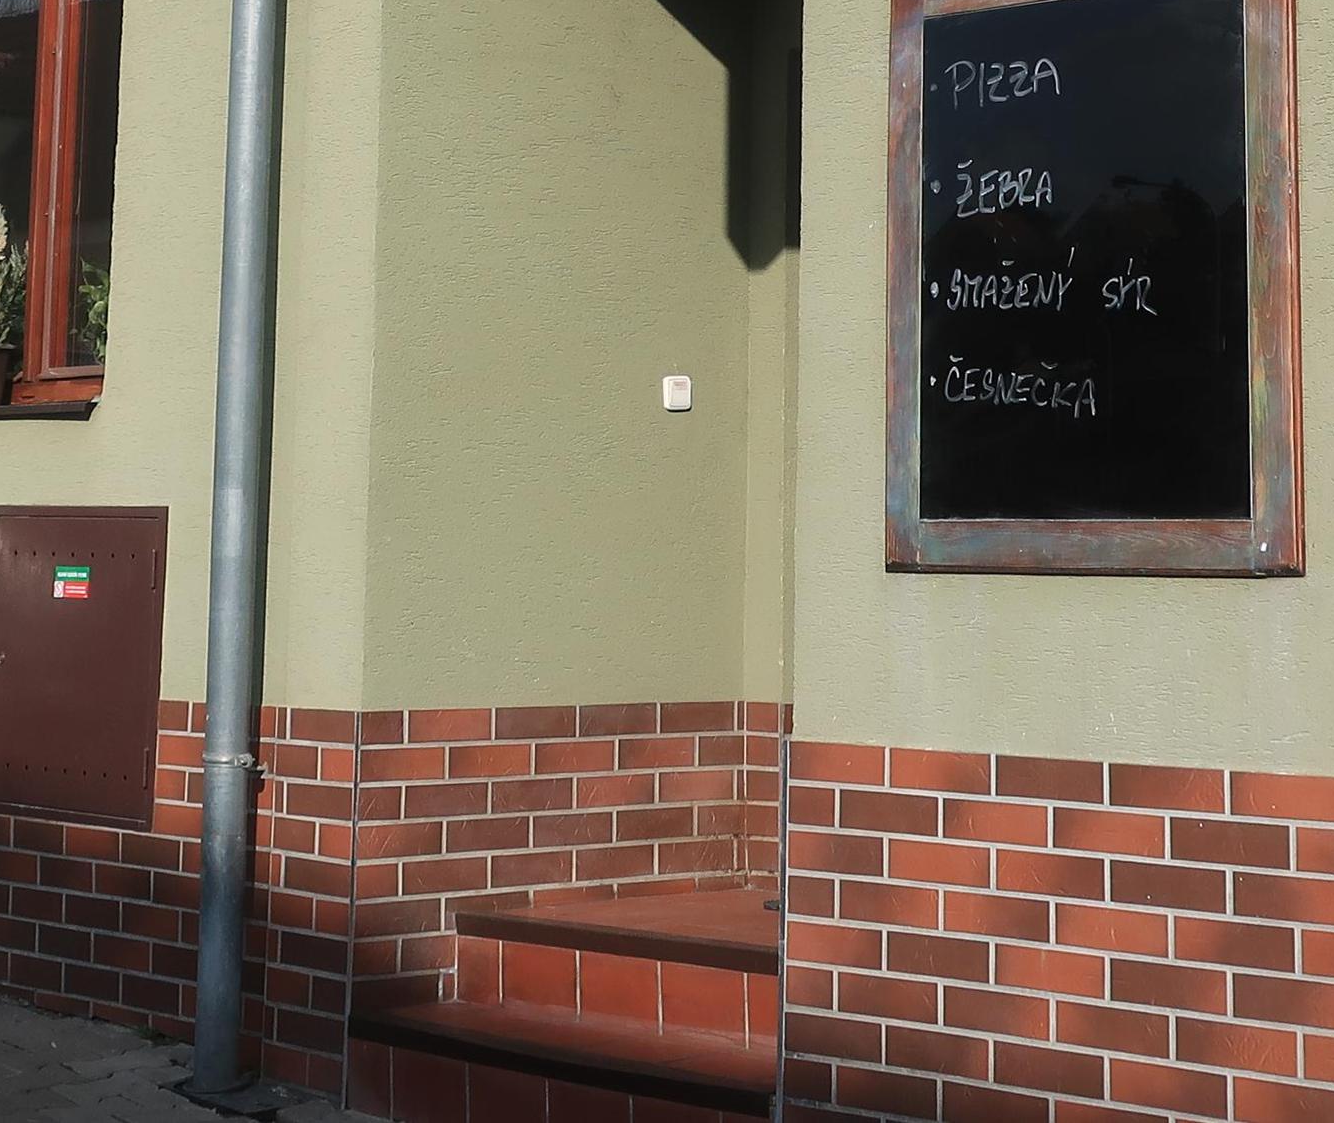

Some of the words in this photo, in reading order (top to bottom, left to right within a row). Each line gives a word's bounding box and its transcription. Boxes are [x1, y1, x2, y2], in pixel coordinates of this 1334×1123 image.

[944, 57, 1061, 111] PIZZA
[955, 158, 1053, 219] ŽEBRA
[946, 246, 1075, 312] SMAŽENÝ
[1101, 257, 1158, 317] SÝR
[944, 354, 1097, 420] ČESNEČKA
